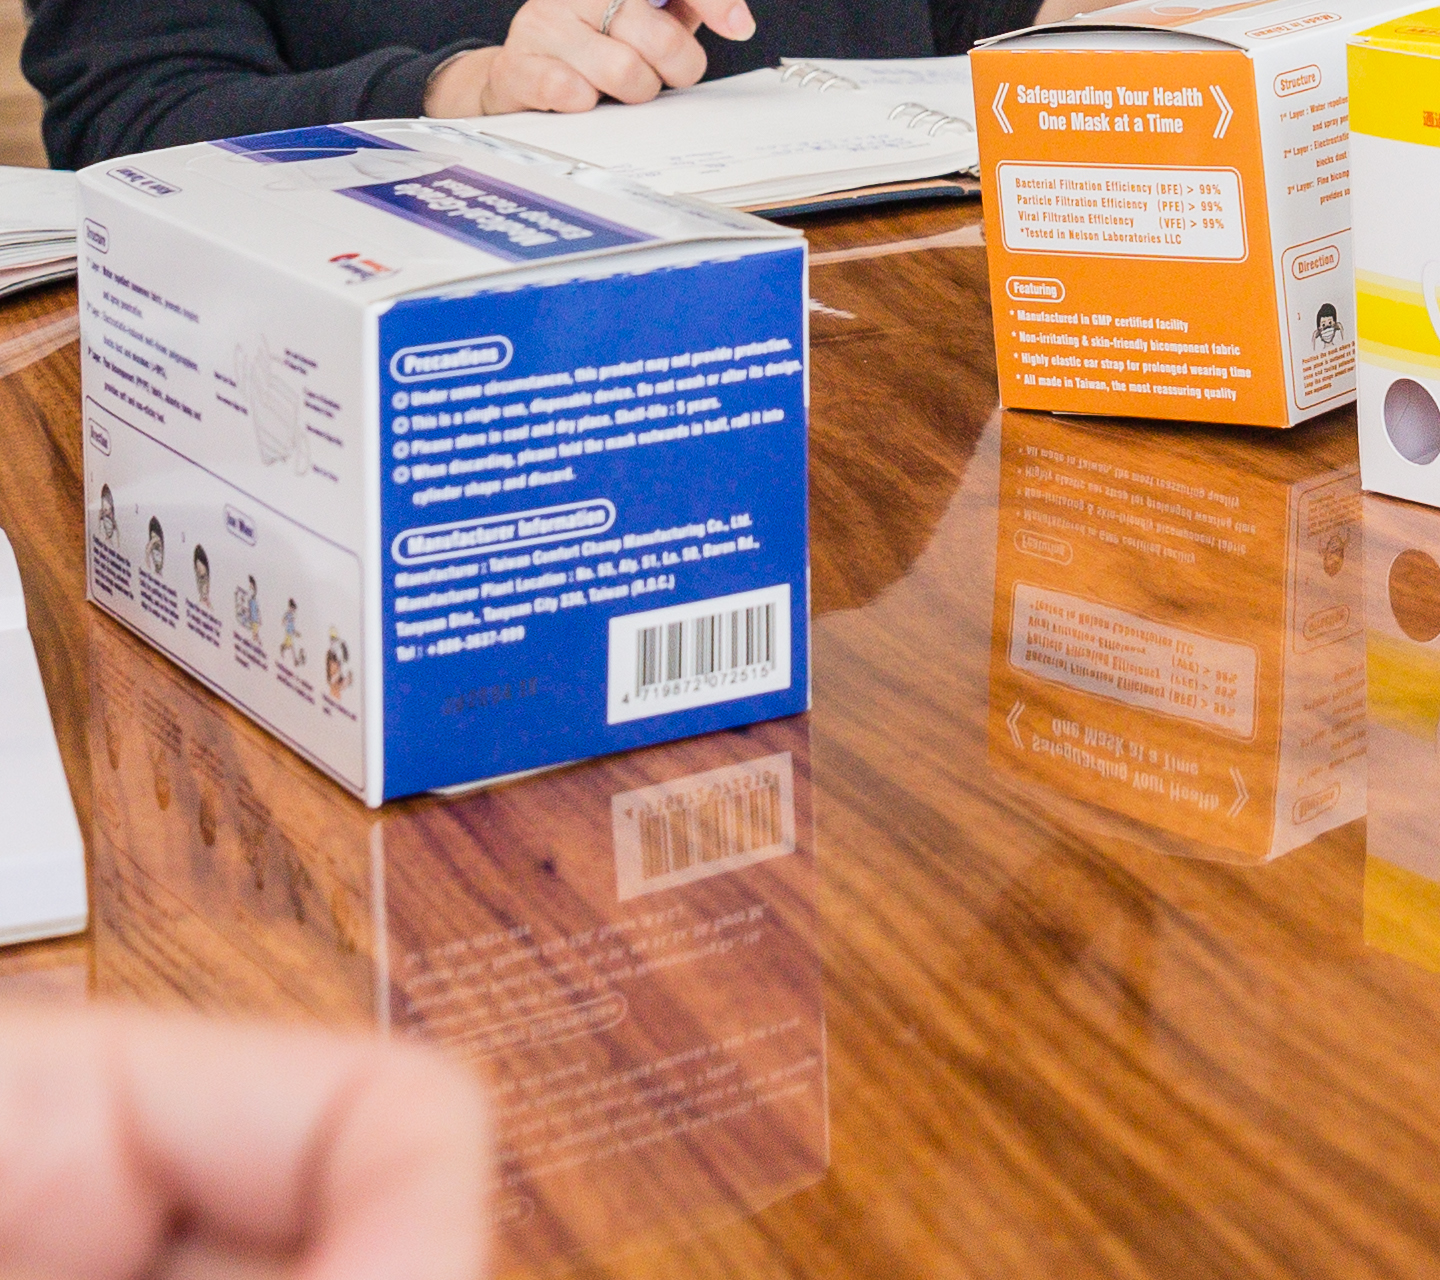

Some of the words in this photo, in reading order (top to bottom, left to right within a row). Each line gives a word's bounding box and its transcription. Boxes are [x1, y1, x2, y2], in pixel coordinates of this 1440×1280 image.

[1280, 73, 1316, 91] Structure
[1016, 84, 1113, 109] Safeguarding
[1115, 85, 1149, 106] Your
[1152, 86, 1203, 107] Health
[1038, 110, 1067, 130] One
[1070, 111, 1110, 131] Mask
[1113, 113, 1130, 132] at
[1132, 116, 1144, 132] a
[1145, 112, 1183, 133] Time
[1014, 177, 1056, 189] Bacterial
[1059, 178, 1102, 191] Filtration
[1104, 180, 1151, 195] Efficiency
[1155, 182, 1182, 195] (BFE)
[1198, 183, 1221, 195] 99%
[1016, 193, 1052, 206] Particle
[1054, 195, 1097, 207] Filtration
[1100, 196, 1147, 211] Efficiency
[1157, 200, 1184, 212] (PFE)
[1200, 200, 1222, 211] 99%
[1017, 210, 1039, 221] Viral
[1041, 210, 1084, 223] Filtration
[1087, 212, 1134, 228] Efficiency
[1158, 216, 1185, 230] (VFE)
[1201, 217, 1224, 229] 99%
[1056, 228, 1065, 239] in
[1068, 229, 1099, 241] Nelson
[1102, 230, 1161, 243] Laboratories
[1164, 233, 1181, 245] LLC
[1298, 254, 1334, 274] Direction
[1013, 282, 1058, 299] Featuring
[1016, 308, 1079, 324] Manufactured
[1080, 312, 1090, 325] in
[1090, 313, 1112, 326] GMP
[1114, 315, 1154, 329] certified
[1154, 317, 1188, 333] facility
[1018, 330, 1079, 348] Non-irritating
[1080, 334, 1089, 346] &
[1090, 335, 1148, 352] skin-friendly
[1149, 339, 1210, 355] bicomponent
[1210, 342, 1241, 356] fabric
[404, 346, 500, 374] Precautions
[1020, 351, 1049, 367] Highly
[1050, 354, 1082, 367] elastic
[1082, 358, 1098, 368] ear
[1099, 358, 1125, 372] strap
[1125, 359, 1140, 371] for
[1141, 361, 1188, 376] prolonged
[1188, 364, 1228, 379] wearing
[1228, 365, 1252, 378] time
[1023, 373, 1036, 385] All
[1037, 375, 1062, 387] made
[1063, 376, 1073, 387] in
[1074, 376, 1110, 392] Taiwan,
[1110, 379, 1126, 392] the
[1128, 382, 1151, 393] most
[1152, 384, 1202, 399] reassuring
[1203, 386, 1236, 401] quality
[407, 524, 514, 555] Manufacturer
[518, 508, 606, 537] Information
